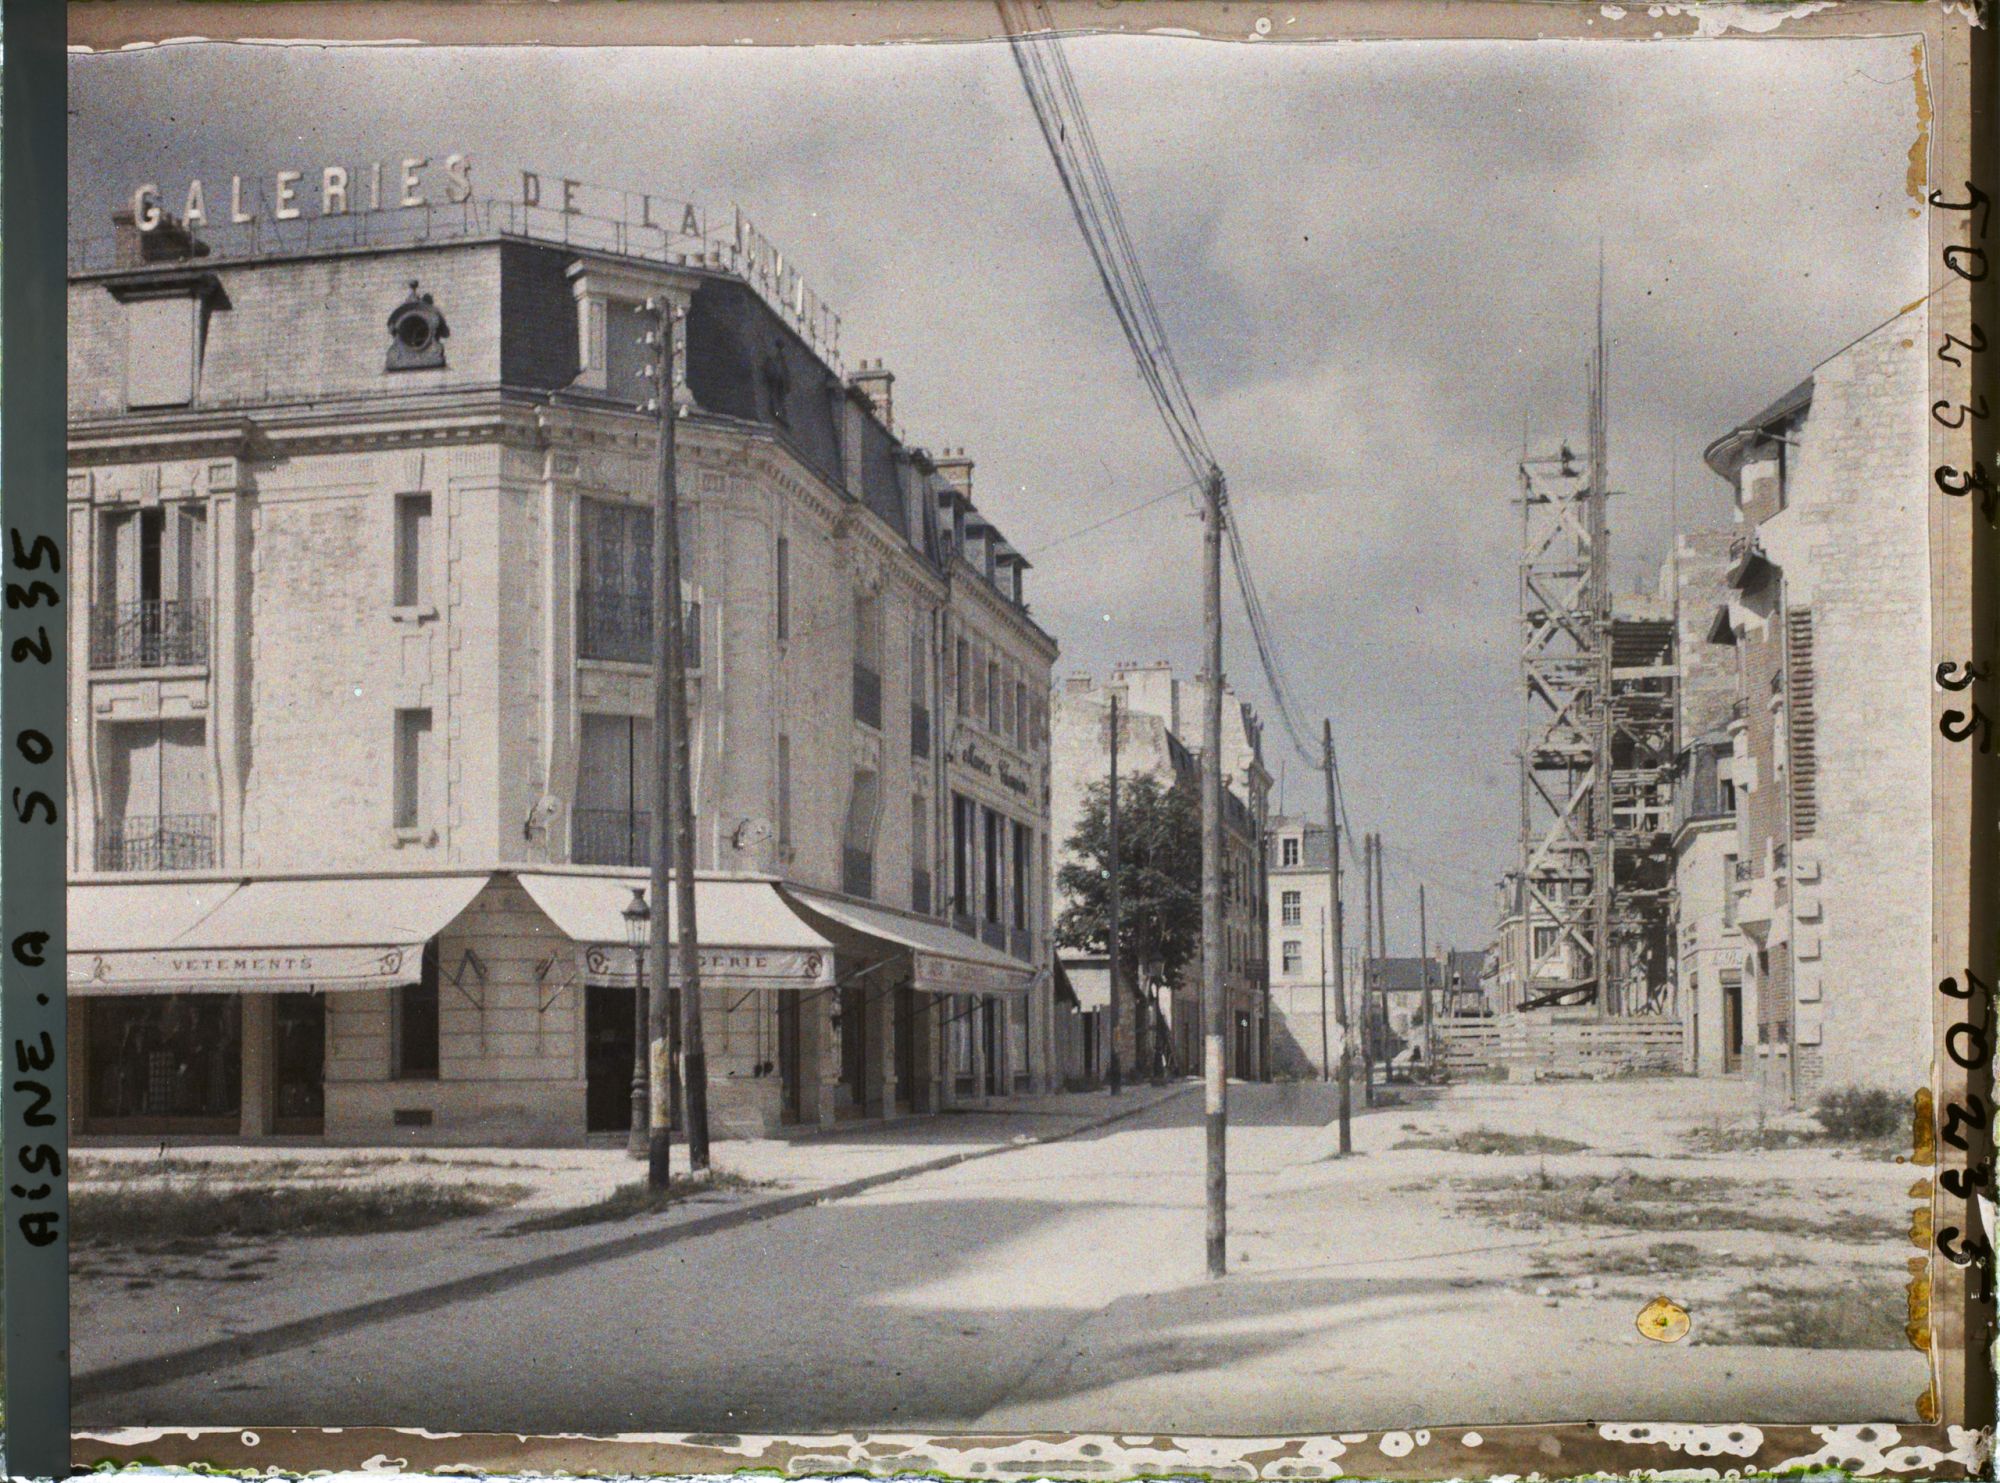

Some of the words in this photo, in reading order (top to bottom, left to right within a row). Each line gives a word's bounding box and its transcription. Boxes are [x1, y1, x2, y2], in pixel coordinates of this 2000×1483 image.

[133, 152, 474, 232] GALERIES
[521, 170, 583, 215] DE
[642, 195, 699, 238] LA
[6, 527, 61, 664] 235
[13, 729, 57, 825] 50
[171, 955, 313, 972] VETEMENTS
